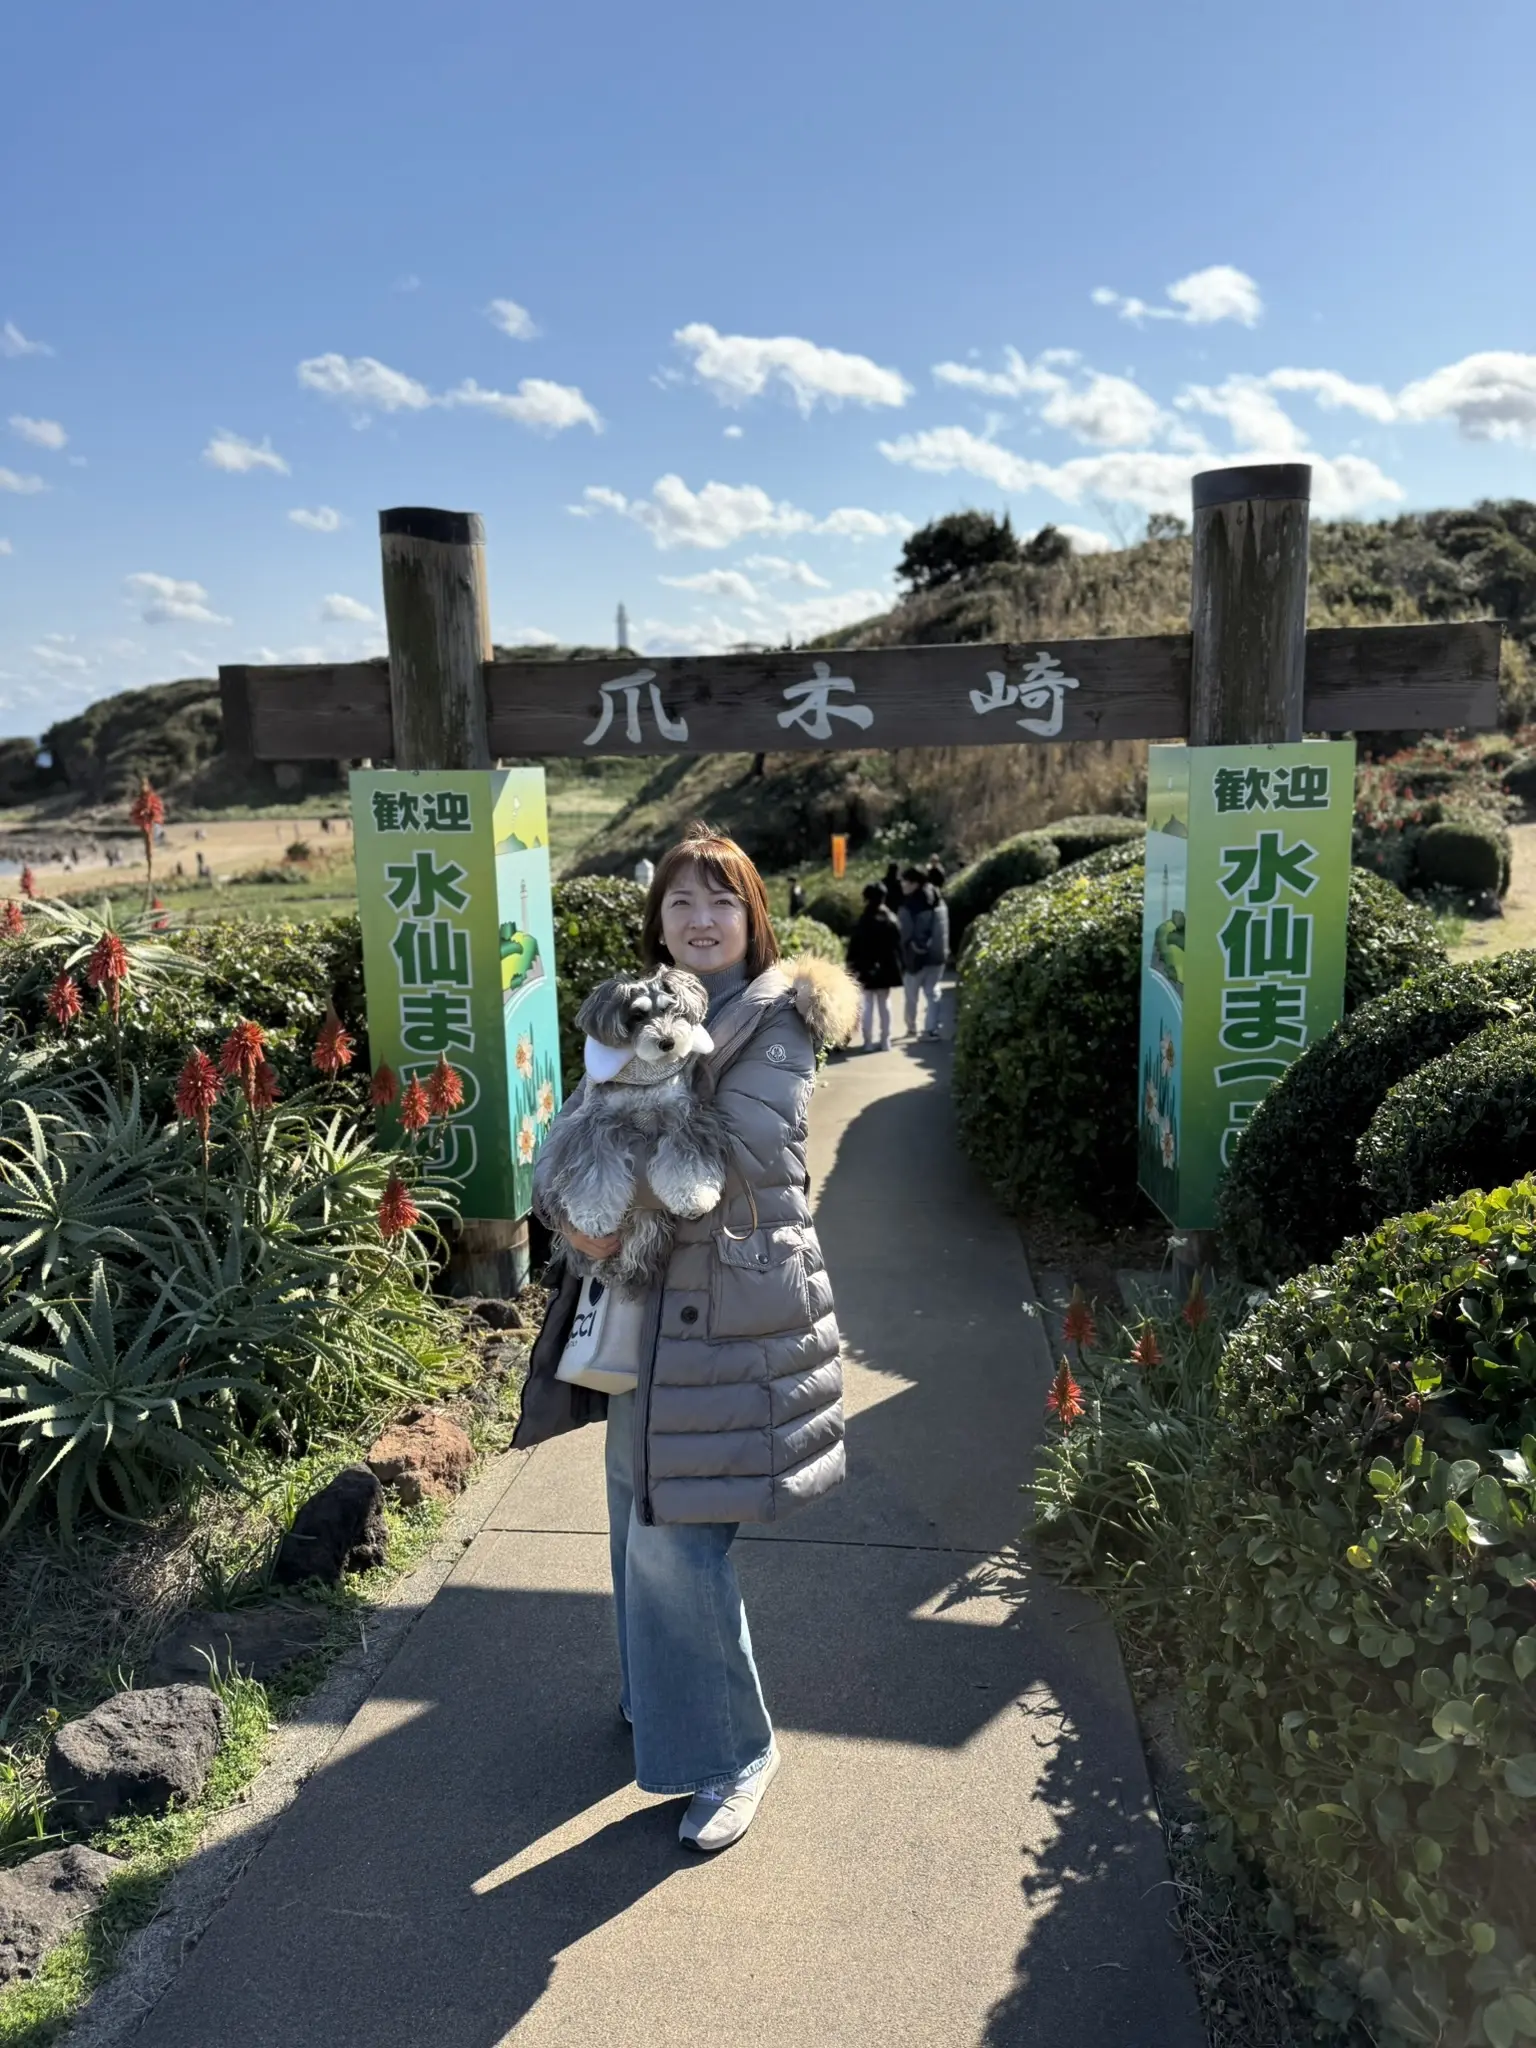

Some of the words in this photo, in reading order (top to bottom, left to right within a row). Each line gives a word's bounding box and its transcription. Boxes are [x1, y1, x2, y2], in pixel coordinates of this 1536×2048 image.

[582, 651, 1080, 746] 爪木崎
[372, 790, 473, 834] 歓迎
[1212, 764, 1331, 814] 歓迎
